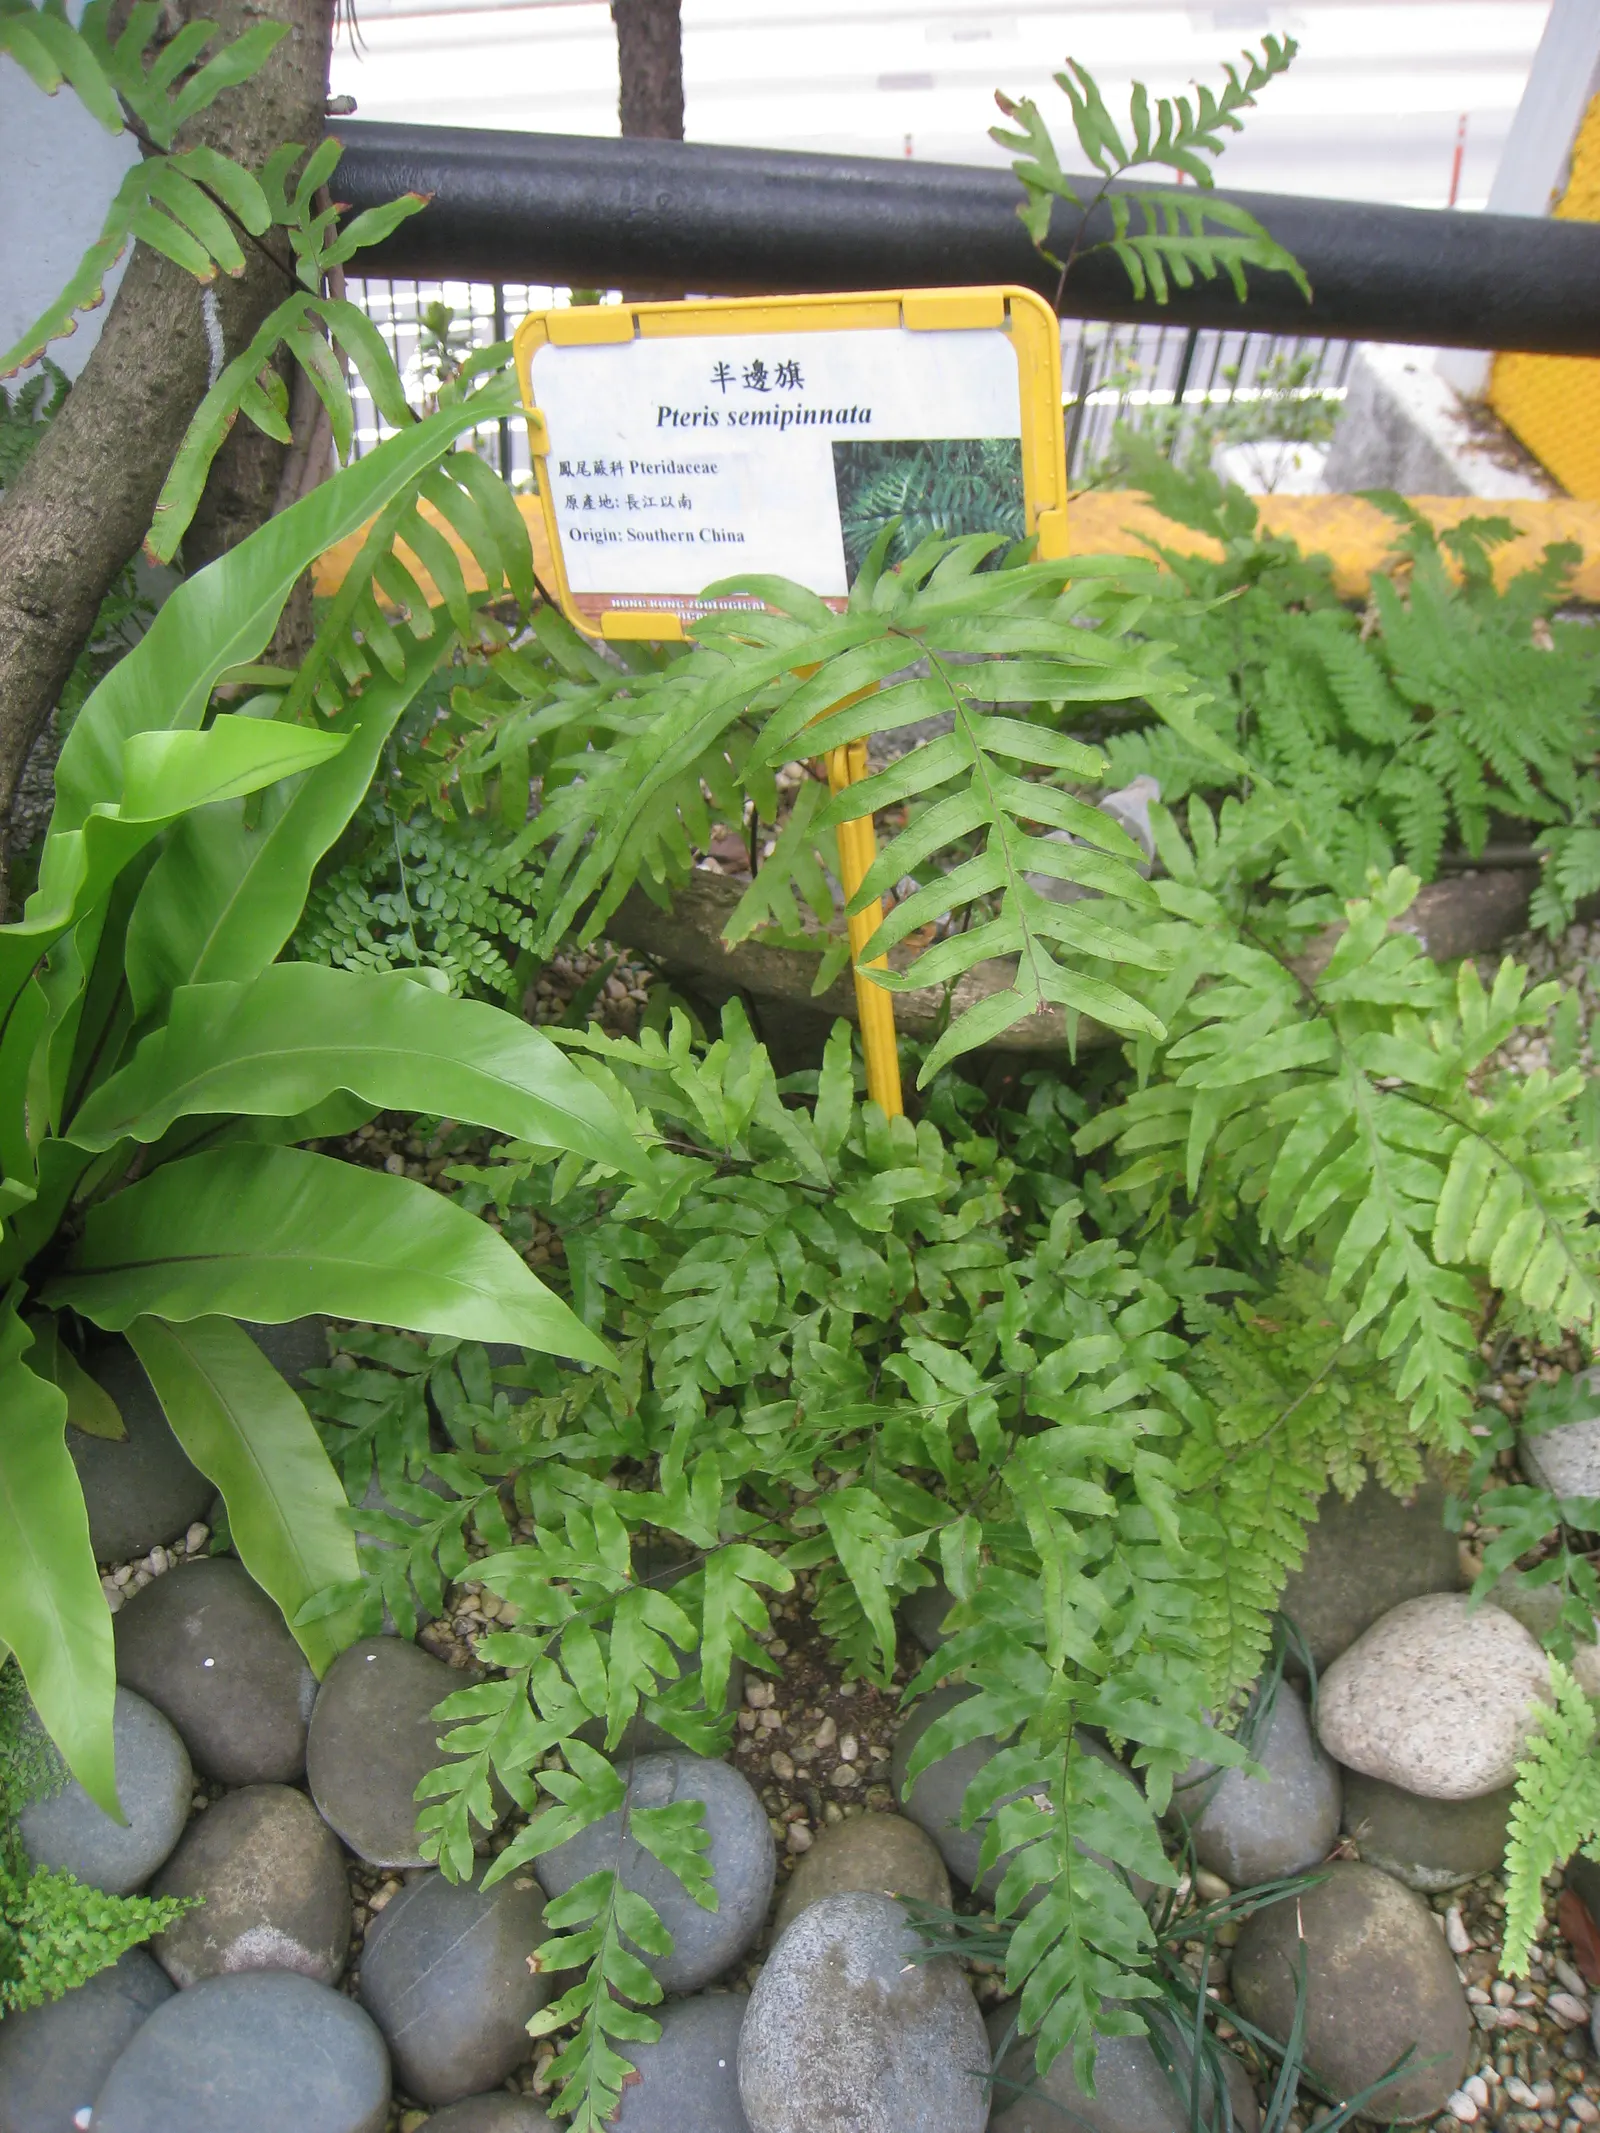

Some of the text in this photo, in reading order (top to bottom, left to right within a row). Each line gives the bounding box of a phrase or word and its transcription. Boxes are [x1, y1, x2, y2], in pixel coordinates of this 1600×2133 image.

[710, 359, 805, 394] 半邊旗
[656, 403, 873, 431] Pteris semipinnata
[559, 460, 719, 478] 鳳尾蕨科 Pteridaceae
[569, 527, 746, 544] Origin: Southern China
